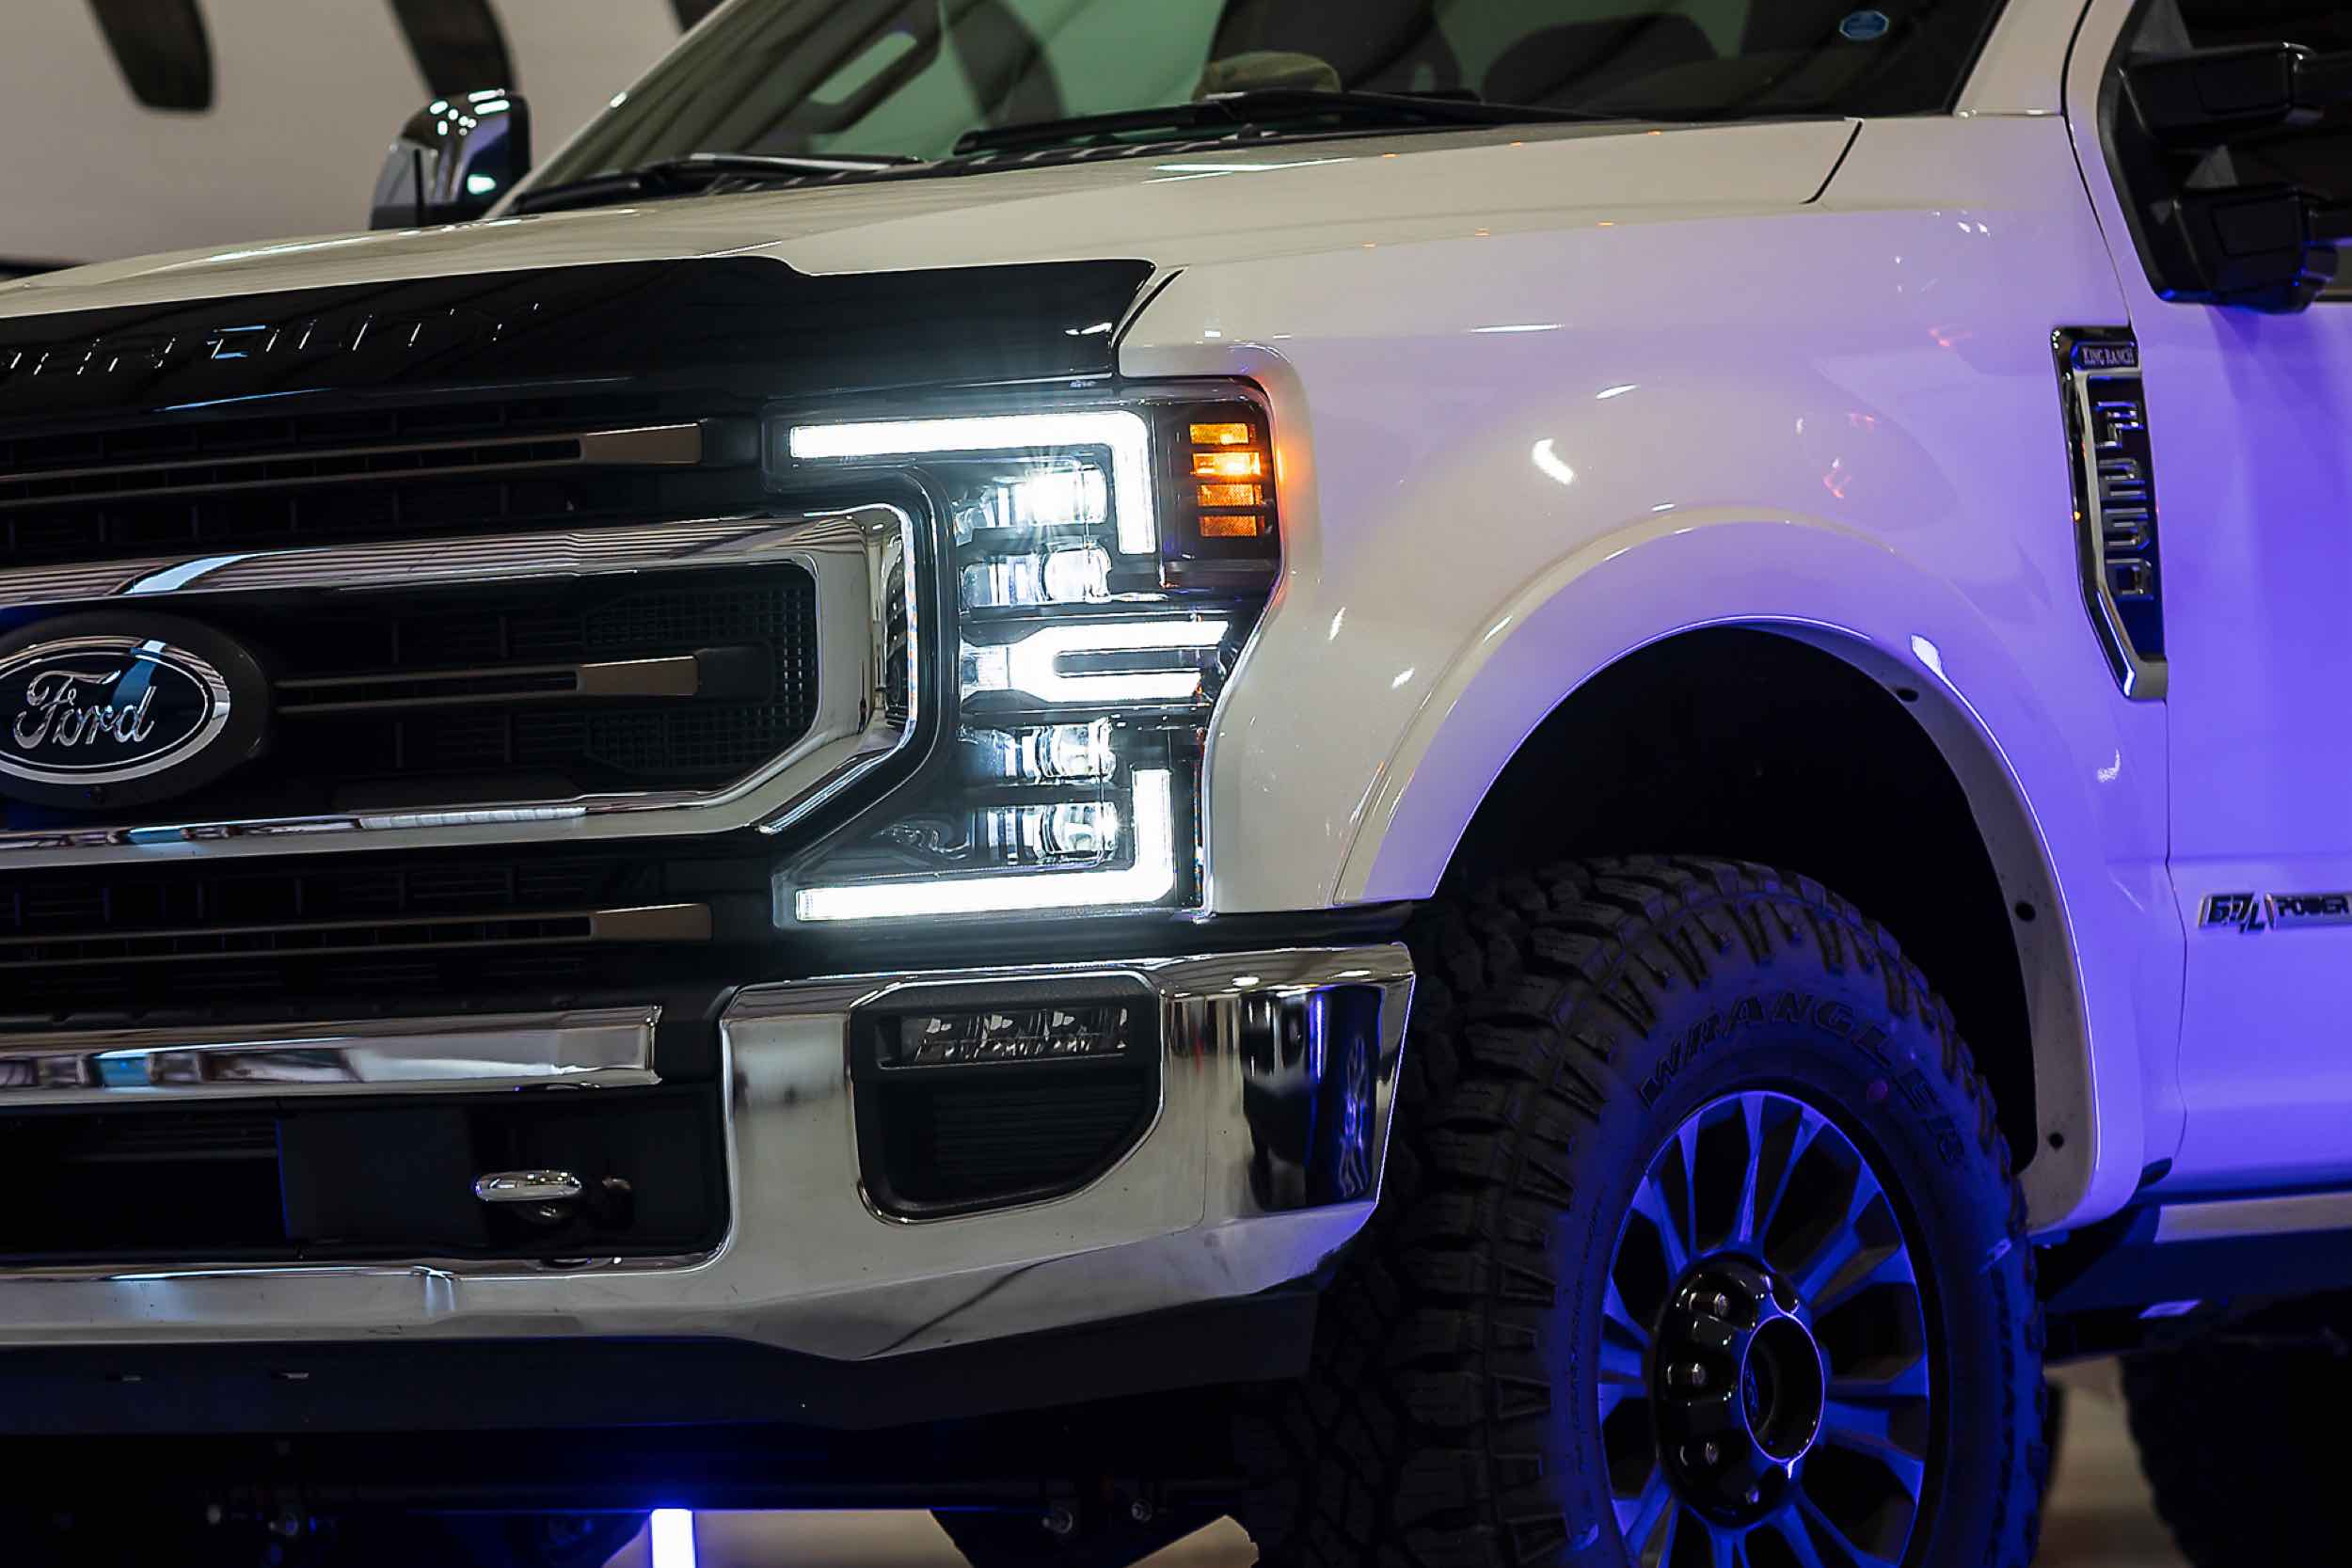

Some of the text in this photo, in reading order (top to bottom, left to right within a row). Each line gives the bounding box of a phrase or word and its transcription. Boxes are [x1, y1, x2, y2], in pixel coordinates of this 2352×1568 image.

[2082, 346, 2135, 366] KING RANCH
[13, 670, 157, 750] Ford
[2274, 895, 2349, 917] POWER
[1639, 990, 1966, 1164] WRANGLER
